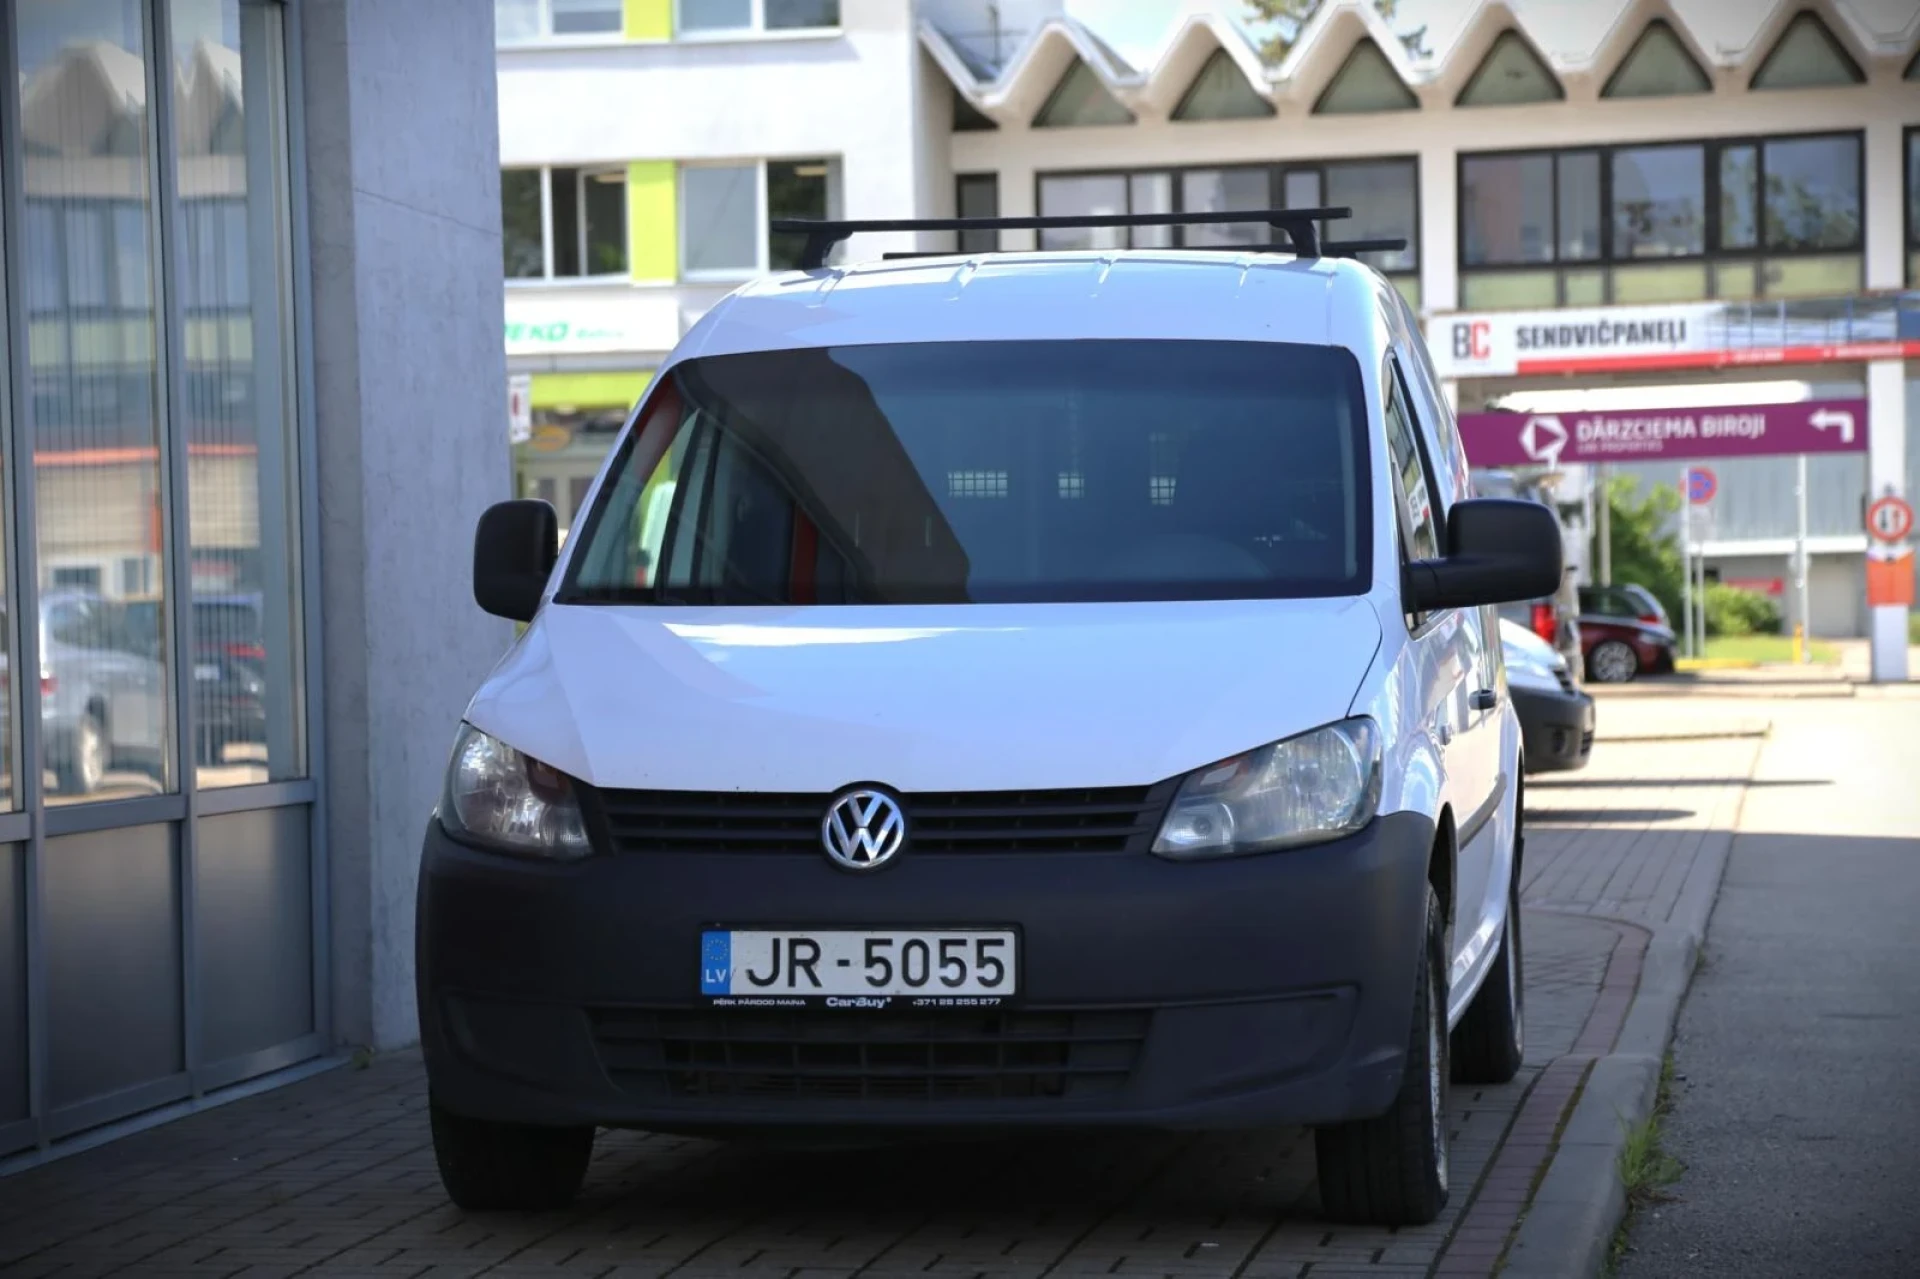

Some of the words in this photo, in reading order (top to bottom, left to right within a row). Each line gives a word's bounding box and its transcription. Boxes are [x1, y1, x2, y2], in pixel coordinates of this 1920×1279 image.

[1453, 321, 1490, 359] BC
[1516, 319, 1687, 350] SENDVIČPANEĻI
[1576, 415, 1697, 443] DĀRZCIEMA
[1701, 413, 1766, 439] BIROJI
[705, 969, 726, 983] LV
